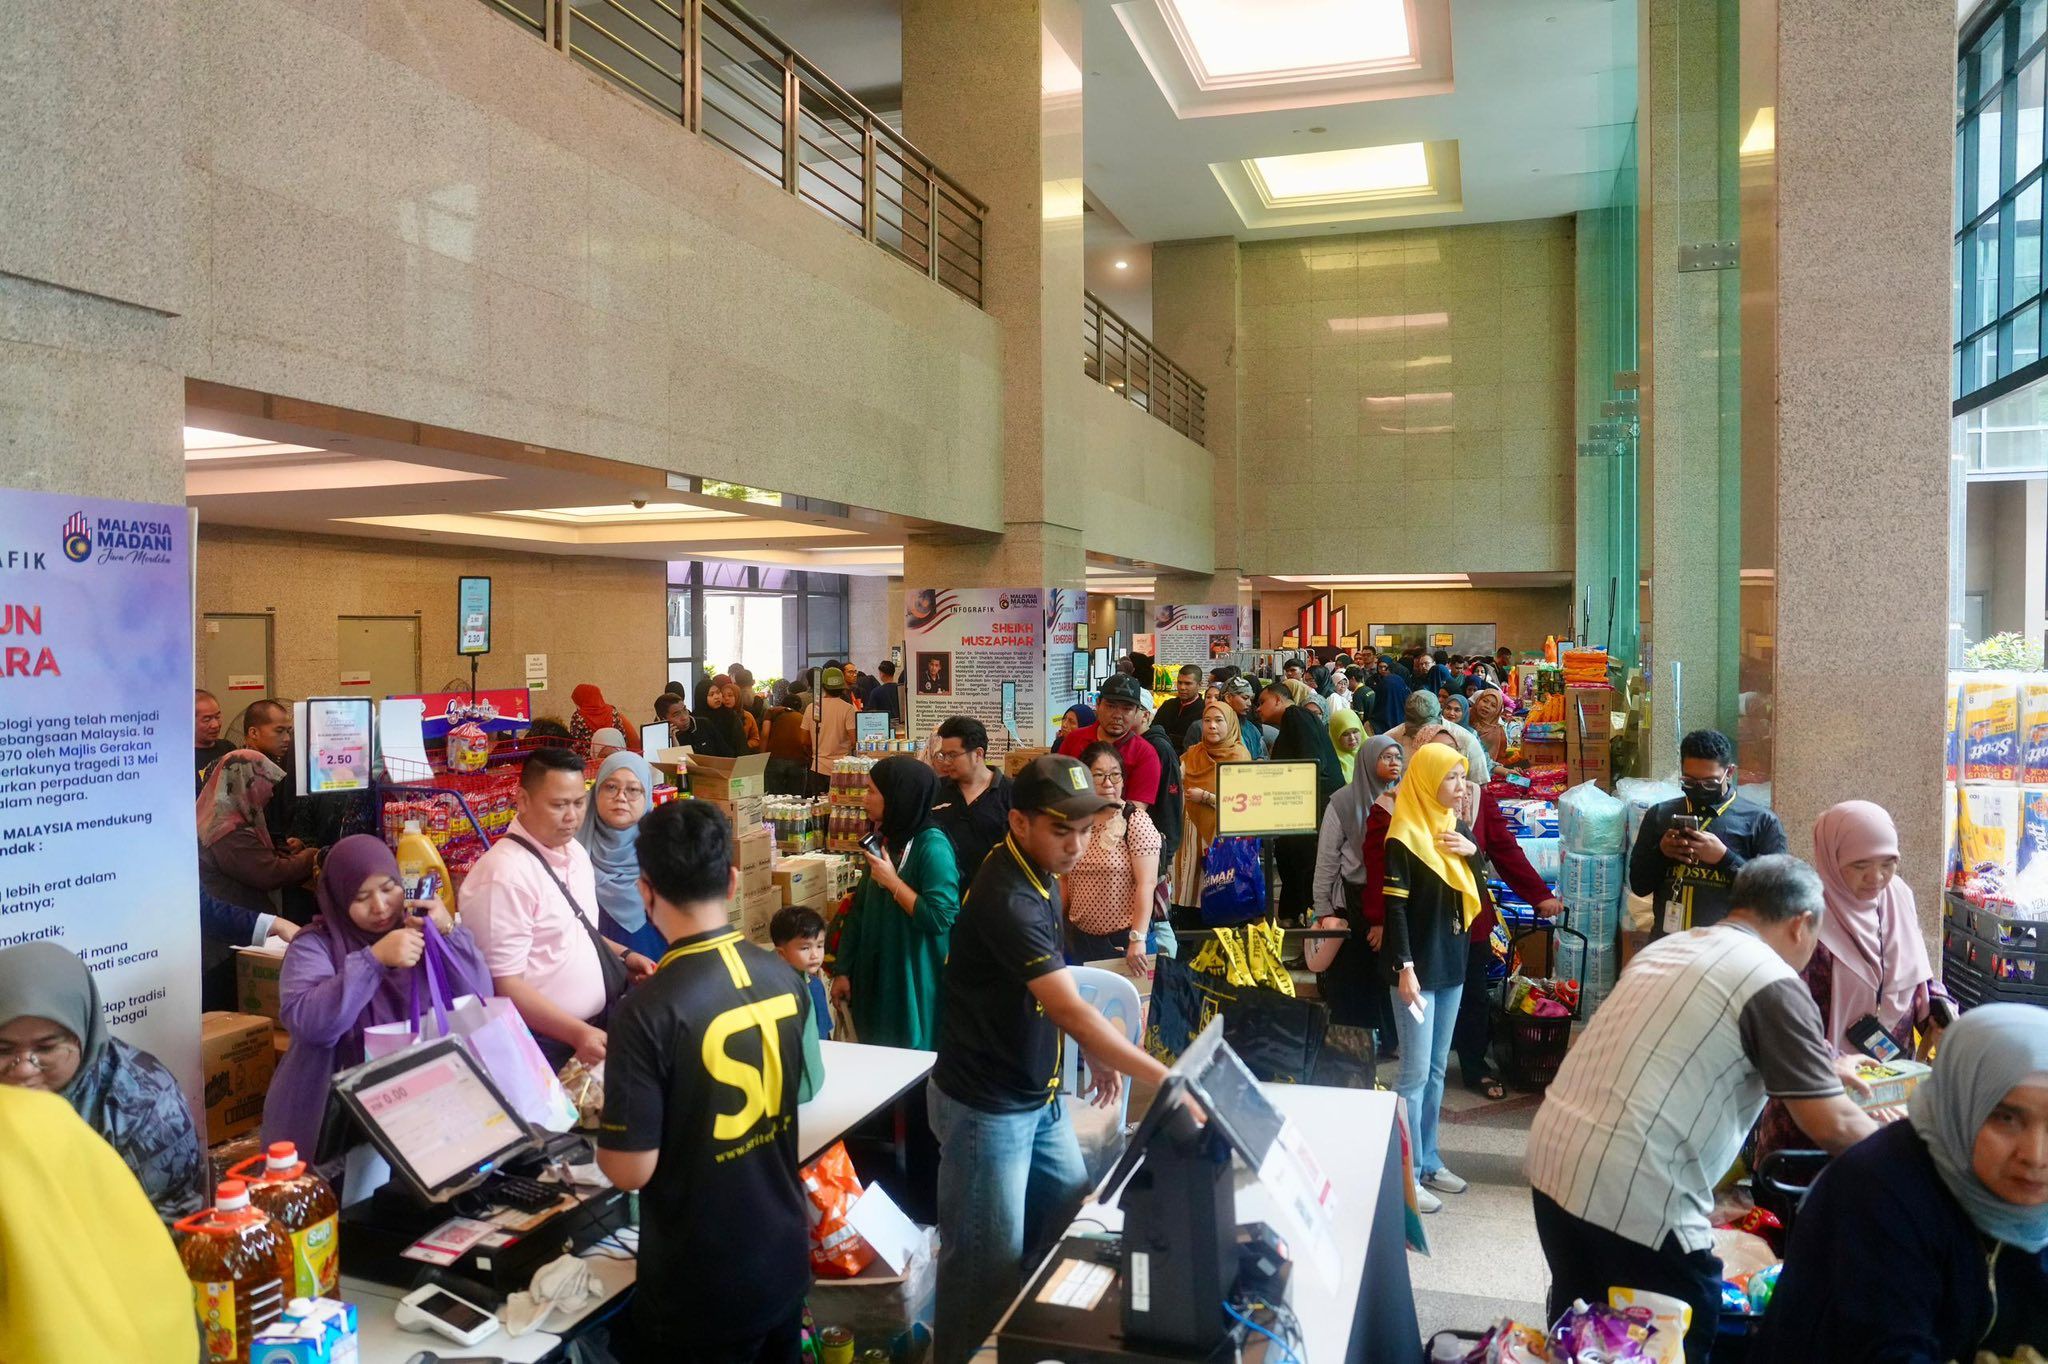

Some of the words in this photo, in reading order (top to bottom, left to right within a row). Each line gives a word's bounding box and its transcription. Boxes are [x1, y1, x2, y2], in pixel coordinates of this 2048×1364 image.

[97, 518, 172, 535] MALAYSIA
[97, 532, 172, 551] MADANI
[0, 551, 46, 570] FIK
[991, 623, 1034, 634] SHEIKH
[961, 636, 1034, 647] MUSZAPHAR
[0, 646, 61, 677] RA
[36, 717, 71, 731] yang
[74, 713, 106, 726] telah
[110, 710, 159, 725] menjadi
[81, 725, 140, 741] Malaysia.
[26, 747, 55, 760] oleh
[59, 743, 96, 759] Majlis
[100, 741, 152, 754] Gerakan
[1968, 737, 2012, 760] Scott
[75, 756, 120, 773] tragedi
[124, 755, 135, 766] 13
[138, 752, 158, 765] Mei
[326, 754, 352, 765] 2.50
[41, 774, 113, 793] perpaduan
[117, 770, 140, 781] dan
[37, 790, 88, 806] negara.
[1231, 793, 1248, 813] 3
[3, 822, 73, 840] MALAYSIA
[76, 811, 153, 830] mendukung
[6, 883, 40, 898] lebih
[44, 878, 72, 892] erat
[75, 870, 117, 886] dalam
[91, 942, 128, 957] mana
[117, 949, 158, 966] secara
[129, 986, 166, 1006] tradisi
[702, 993, 798, 1140] ST
[383, 1086, 408, 1105] 0.00
